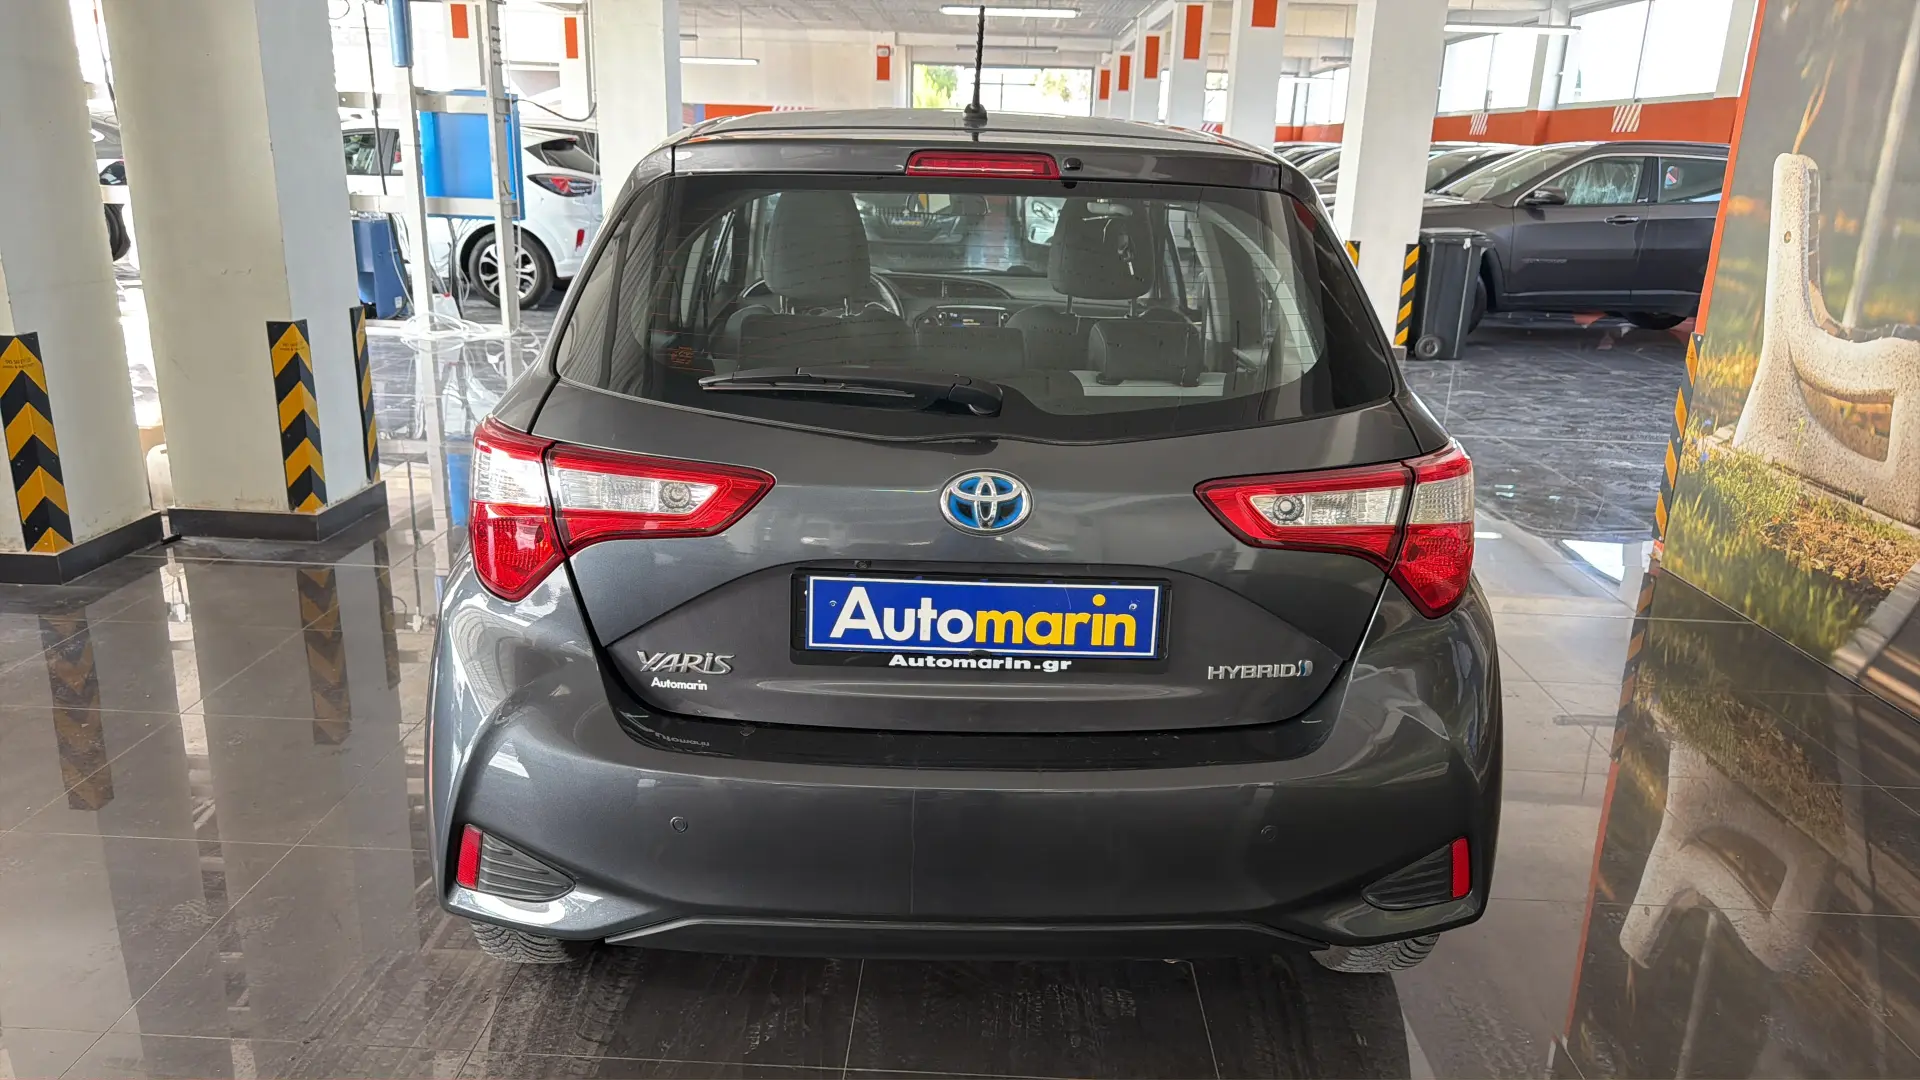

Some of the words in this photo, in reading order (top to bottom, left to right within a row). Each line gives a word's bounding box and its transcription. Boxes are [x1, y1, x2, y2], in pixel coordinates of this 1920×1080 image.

[829, 586, 1137, 647] Automarin
[888, 654, 1072, 673] Automarin.gr
[1207, 663, 1297, 680] HYBRID
[651, 677, 708, 691] Automarin
